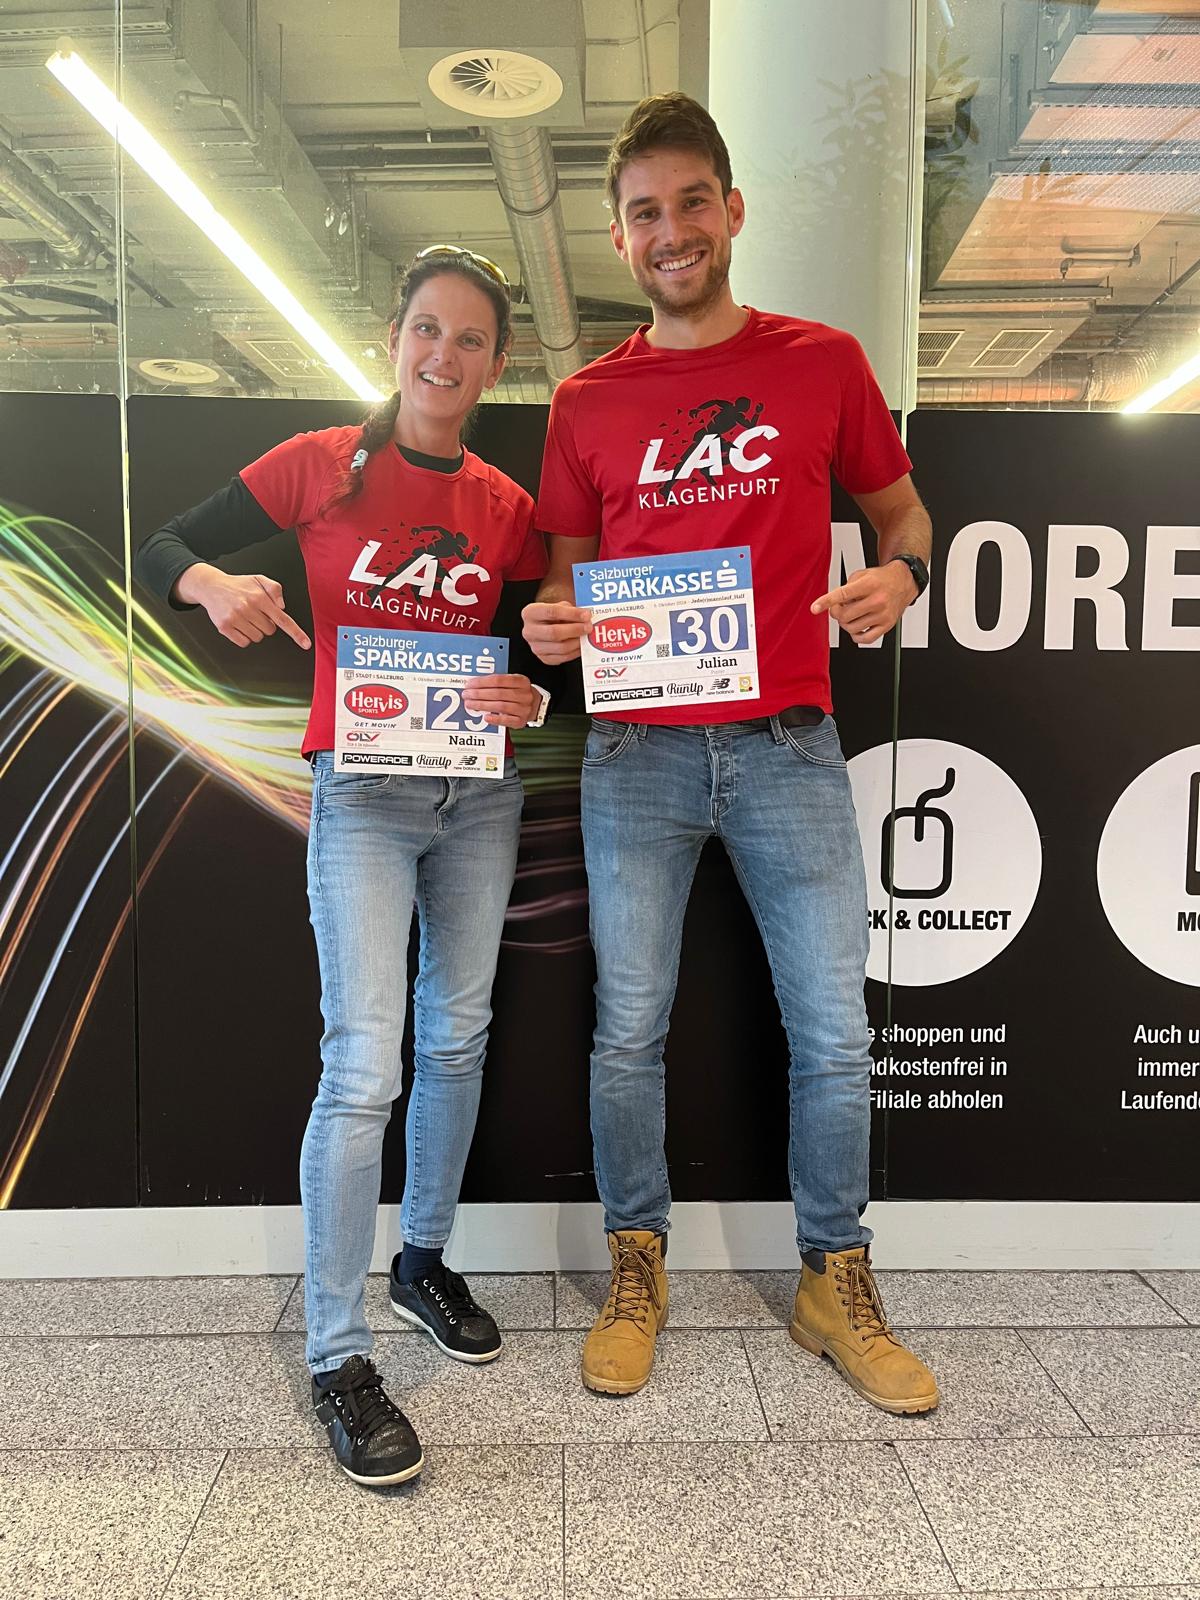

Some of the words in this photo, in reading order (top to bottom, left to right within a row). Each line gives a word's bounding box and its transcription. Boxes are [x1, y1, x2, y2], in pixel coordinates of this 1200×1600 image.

[638, 424, 780, 485] LAC
[638, 478, 780, 510] KLAGENFURT
[348, 540, 490, 606] LAC
[590, 566, 654, 582] Salzburger
[592, 571, 714, 602] SPARKASSE
[346, 588, 480, 630] KLAGENFURT
[594, 625, 647, 645] Hervis
[676, 606, 740, 654] 30
[354, 634, 418, 650] Salzburger
[354, 648, 472, 672] SPARKASSE
[697, 656, 738, 670] Julian
[594, 686, 661, 701] POWERADE
[666, 683, 703, 696] RunUp
[352, 690, 403, 712] Hervis
[449, 735, 485, 746] Nadin
[344, 754, 411, 766] POWERADE
[416, 754, 452, 769] RunUp
[895, 910, 911, 929] &
[918, 910, 1012, 930] COLLECT
[1177, 912, 1200, 931] M
[882, 1024, 964, 1046] shoppen
[970, 1024, 1006, 1043] und
[1133, 1024, 1181, 1044] Auch
[990, 1057, 1007, 1076] in
[1137, 1058, 1200, 1076] immer
[928, 1090, 1004, 1109] abholen
[1121, 1090, 1200, 1110] Laufend
